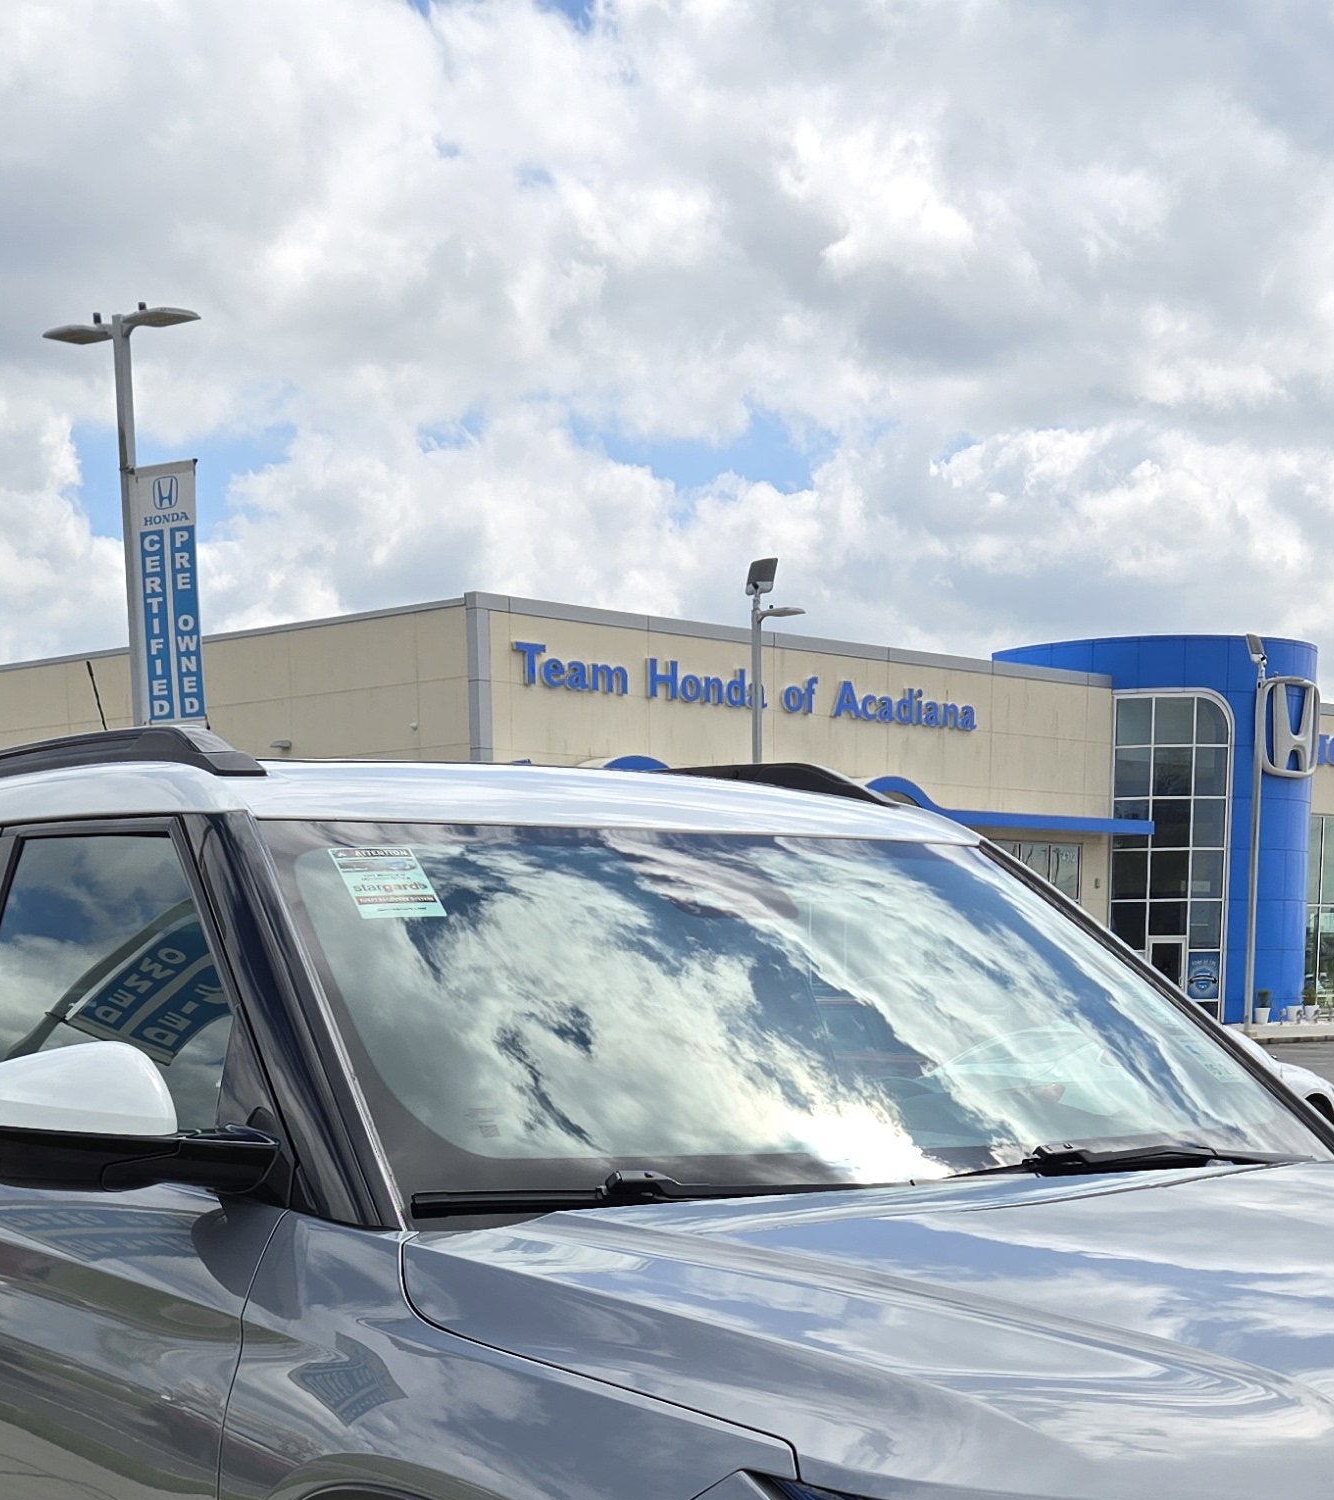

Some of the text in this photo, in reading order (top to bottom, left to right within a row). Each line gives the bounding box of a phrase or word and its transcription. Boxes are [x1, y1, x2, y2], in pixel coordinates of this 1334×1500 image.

[144, 512, 189, 526] HONDA
[143, 535, 170, 716] CERTIFIED
[175, 531, 199, 713] PRE OWNED
[512, 642, 628, 696] Team
[782, 676, 819, 715] of
[831, 680, 977, 732] Acadiana
